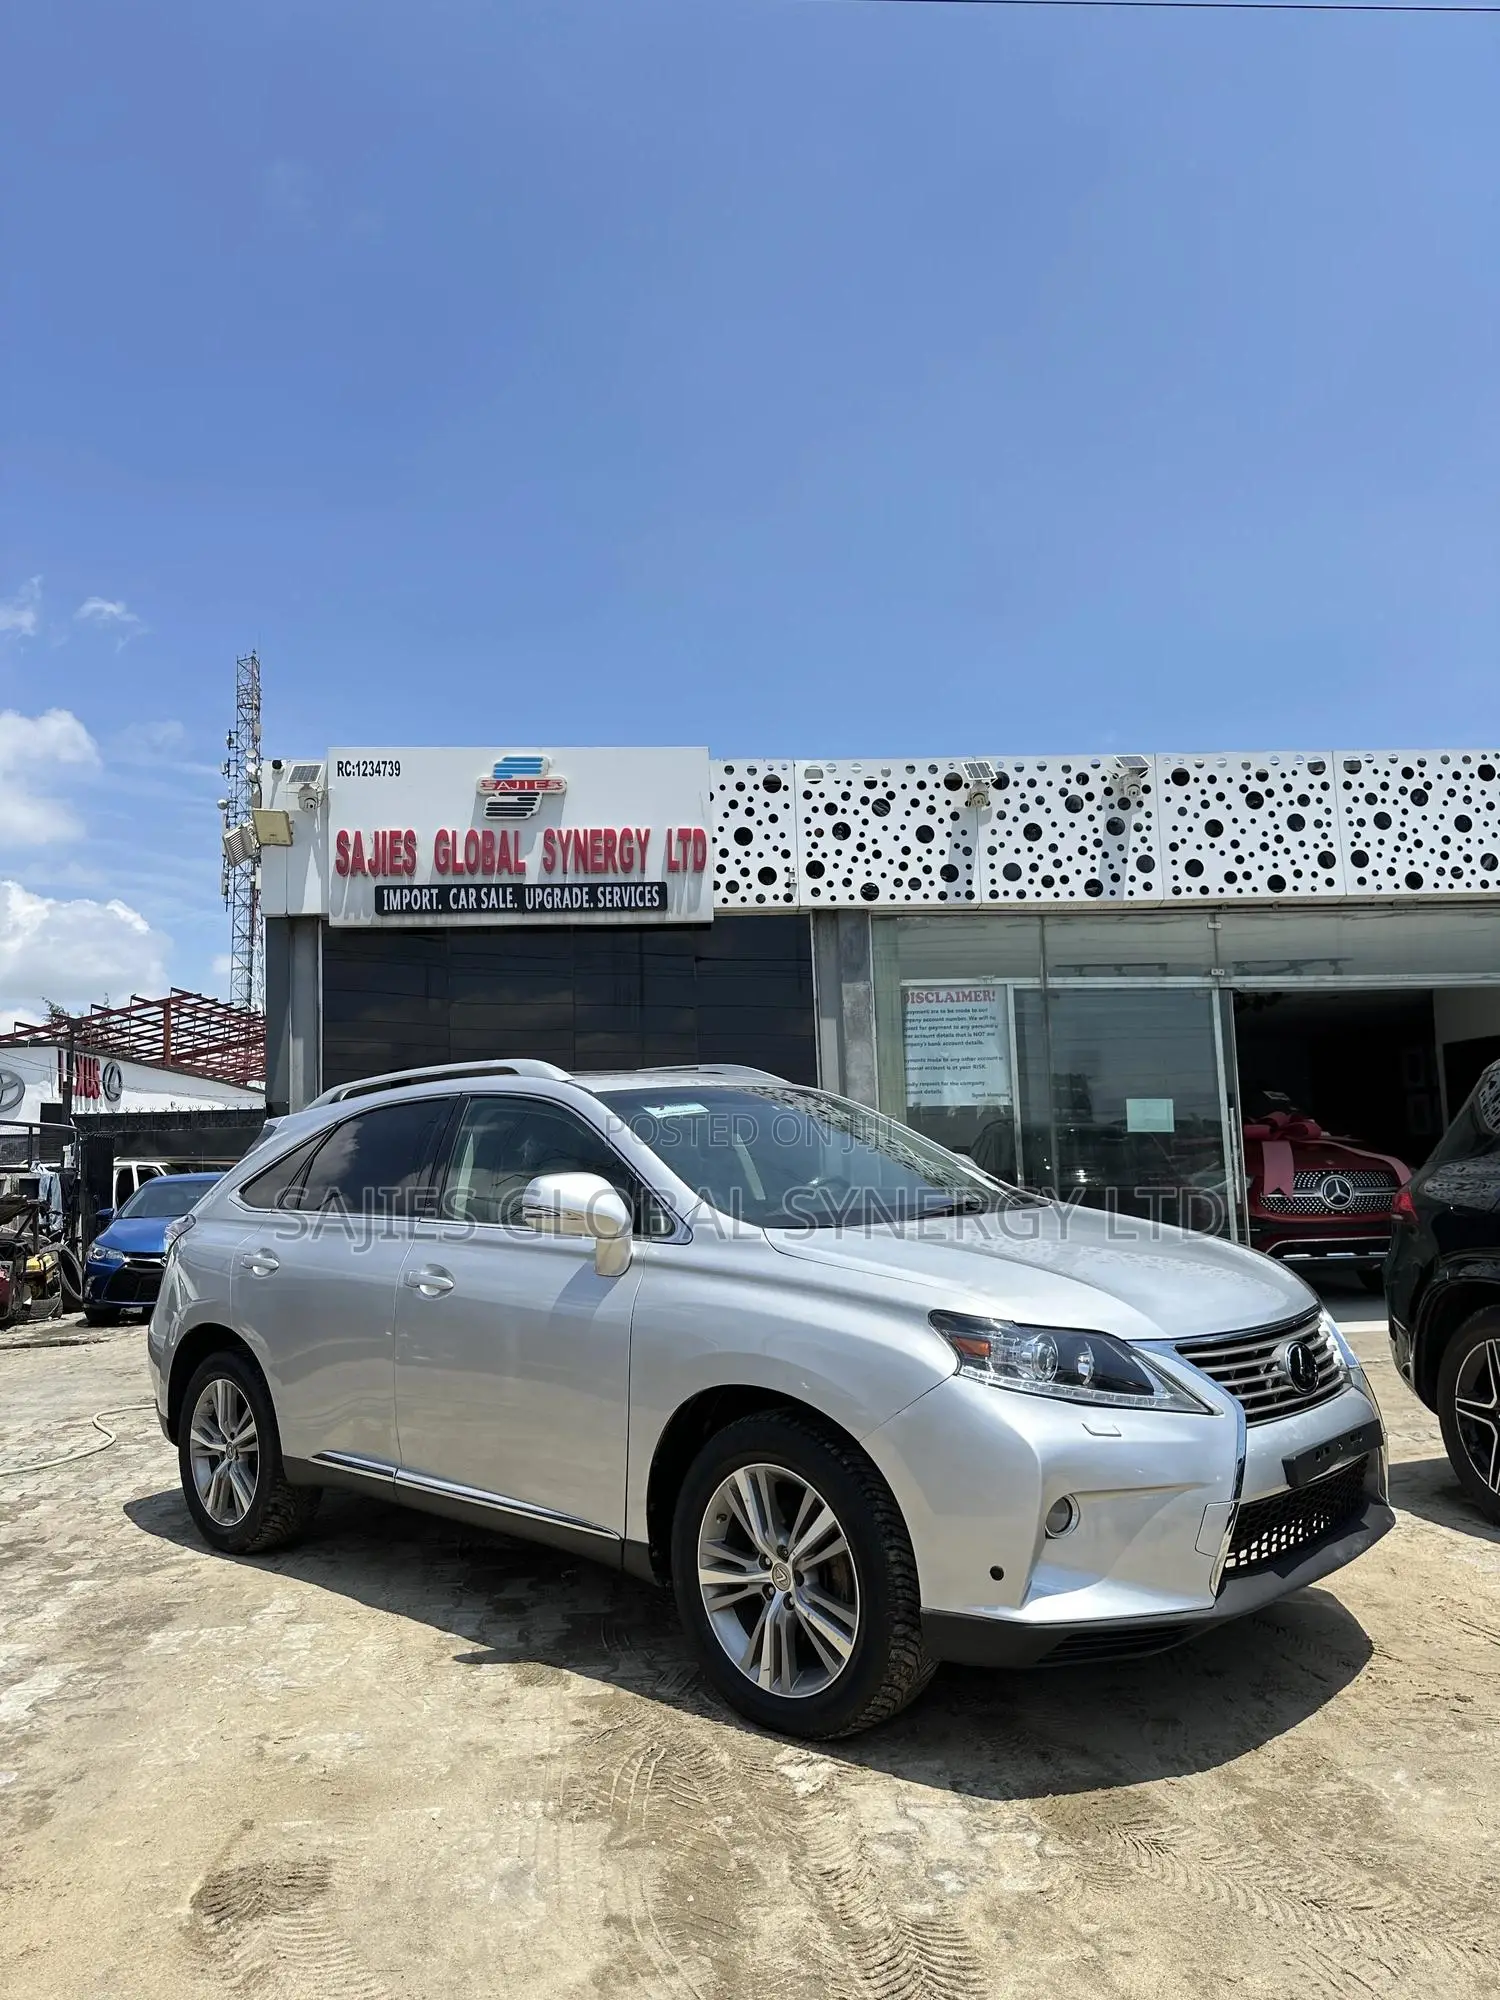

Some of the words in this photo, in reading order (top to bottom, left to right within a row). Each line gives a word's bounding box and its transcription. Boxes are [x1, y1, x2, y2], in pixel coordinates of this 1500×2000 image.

[337, 760, 401, 777] RC:1234739
[480, 780, 563, 791] SAJIES
[335, 829, 417, 876] SAJIES
[434, 829, 526, 875] GLOBAL
[542, 828, 650, 874] SYNERGY
[667, 828, 707, 873] LTD
[383, 888, 442, 911] IMPORT.
[449, 888, 477, 909] CAR
[481, 886, 518, 909] SALE.
[525, 886, 594, 909] UPGRADE.
[598, 885, 660, 908] SERVICES
[904, 990, 996, 1004] DISCLAIMER!
[57, 1049, 101, 1099] LXUS
